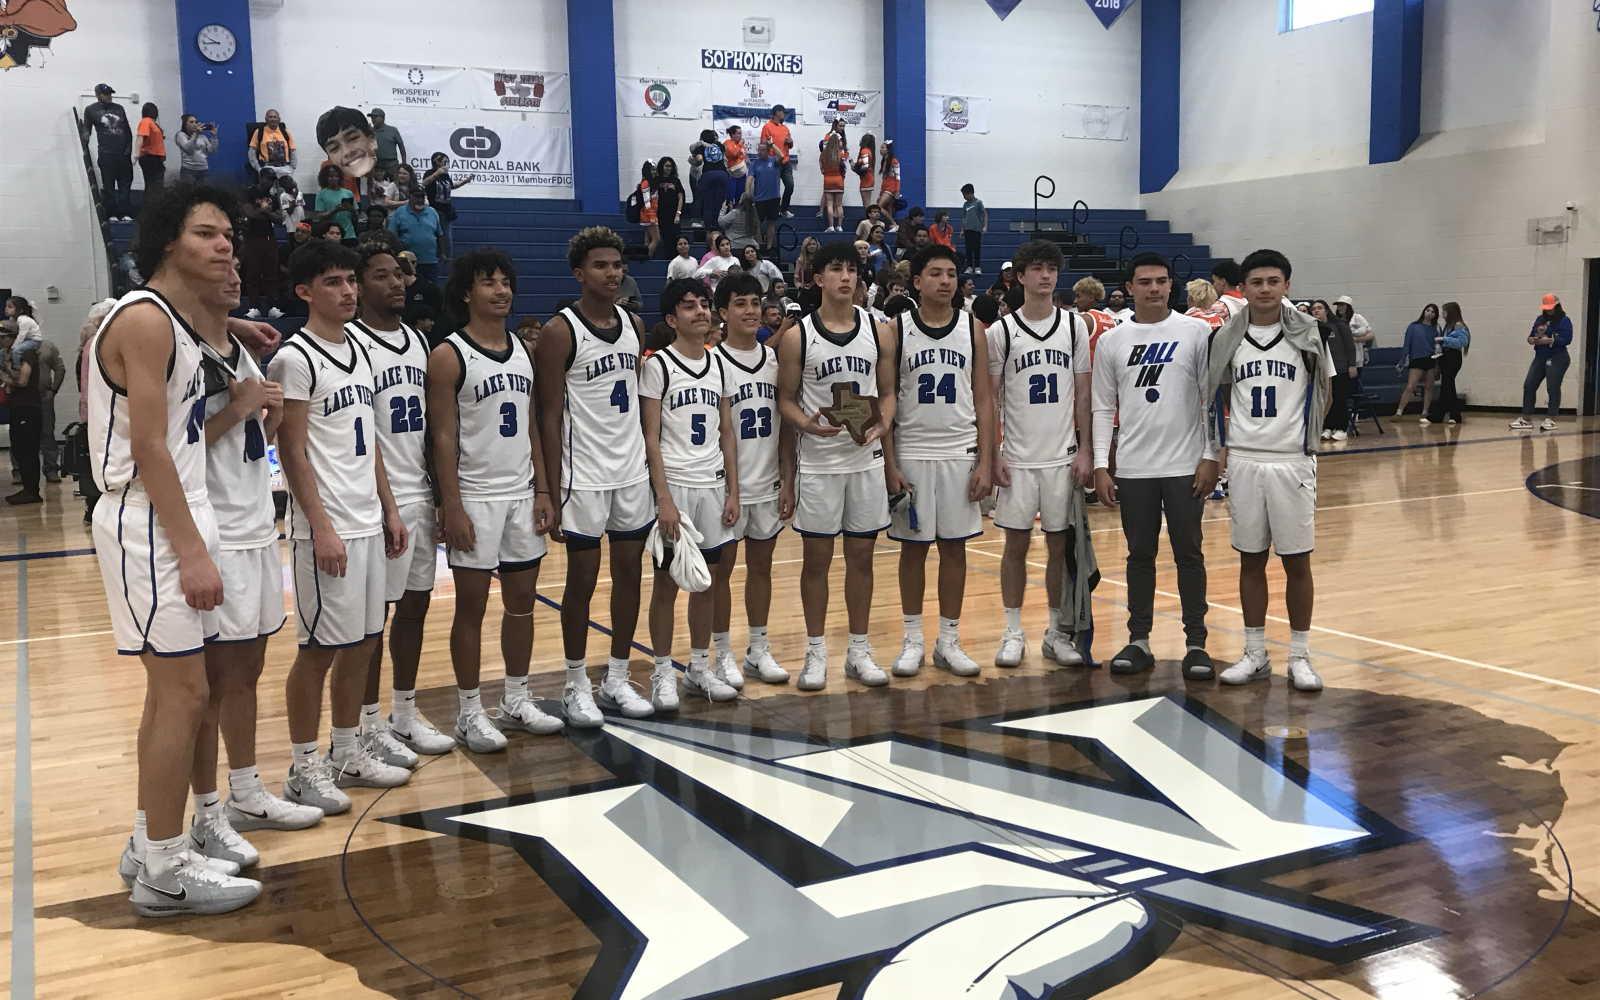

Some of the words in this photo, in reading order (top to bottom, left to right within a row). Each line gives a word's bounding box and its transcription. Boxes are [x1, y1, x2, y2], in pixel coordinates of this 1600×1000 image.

[1094, 0, 1120, 9] 2018
[704, 49, 802, 73] SOPHOMORES
[493, 72, 517, 83] WEST
[520, 75, 545, 85] TEXAS
[392, 87, 441, 97] PROSPERITY
[405, 96, 428, 104] BANK
[500, 96, 541, 107] STRENGTH
[652, 91, 664, 103] 40
[817, 91, 867, 104] LONESTAR
[410, 158, 431, 169] CIT
[449, 159, 503, 171] ATIONAL
[506, 161, 541, 172] BANK
[908, 348, 936, 373] LAKE
[939, 348, 967, 371] VIEW
[1014, 349, 1041, 374] LAKE
[1045, 348, 1070, 370] VIEW
[1127, 341, 1180, 366] BALL
[374, 365, 402, 395] LAKE
[586, 353, 615, 382] LAKE
[617, 352, 638, 371] VIE
[814, 356, 843, 381] LAKE
[845, 355, 872, 377] VIEW
[1134, 364, 1165, 388] IN
[1234, 359, 1262, 383] LAKE
[1266, 359, 1297, 382] VIEW
[323, 385, 355, 417] LAKE
[474, 373, 505, 403] LAKE
[609, 379, 629, 413] 4
[670, 388, 698, 411] LAKE
[918, 373, 956, 404] 24
[1029, 372, 1059, 404] 21
[389, 395, 424, 434] 22
[1251, 386, 1277, 417] 11
[499, 402, 518, 437] 3
[691, 413, 706, 445] 5
[740, 406, 772, 440] 23
[354, 416, 367, 456] 1
